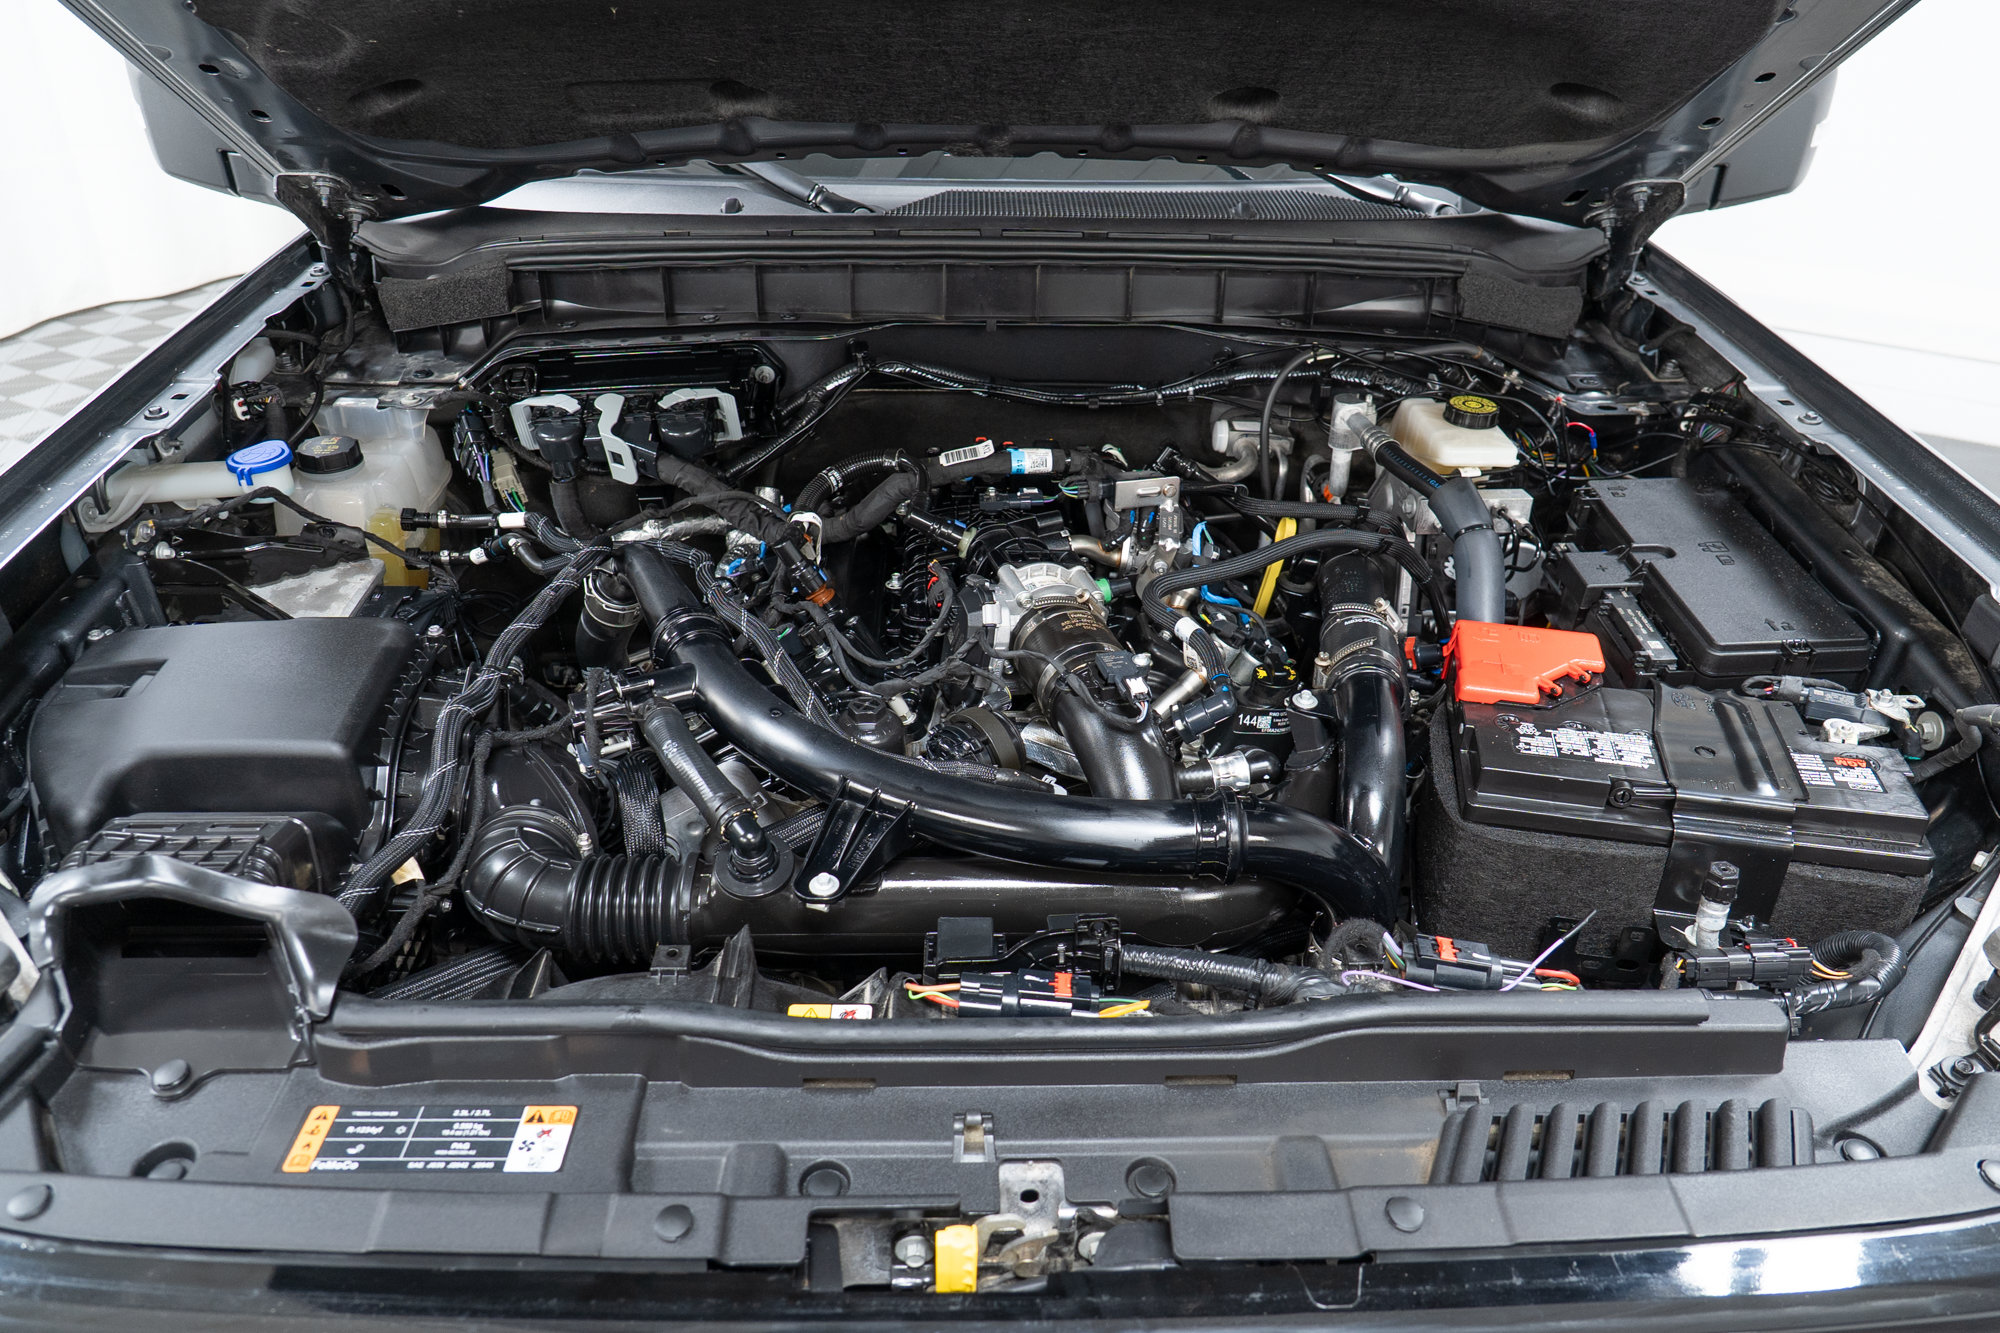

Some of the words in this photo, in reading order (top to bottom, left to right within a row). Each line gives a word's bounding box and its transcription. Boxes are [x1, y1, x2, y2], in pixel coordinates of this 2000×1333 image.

[1238, 713, 1257, 727] 144
[1834, 758, 1867, 769] AGM
[310, 1160, 360, 1170] FoMoCo
